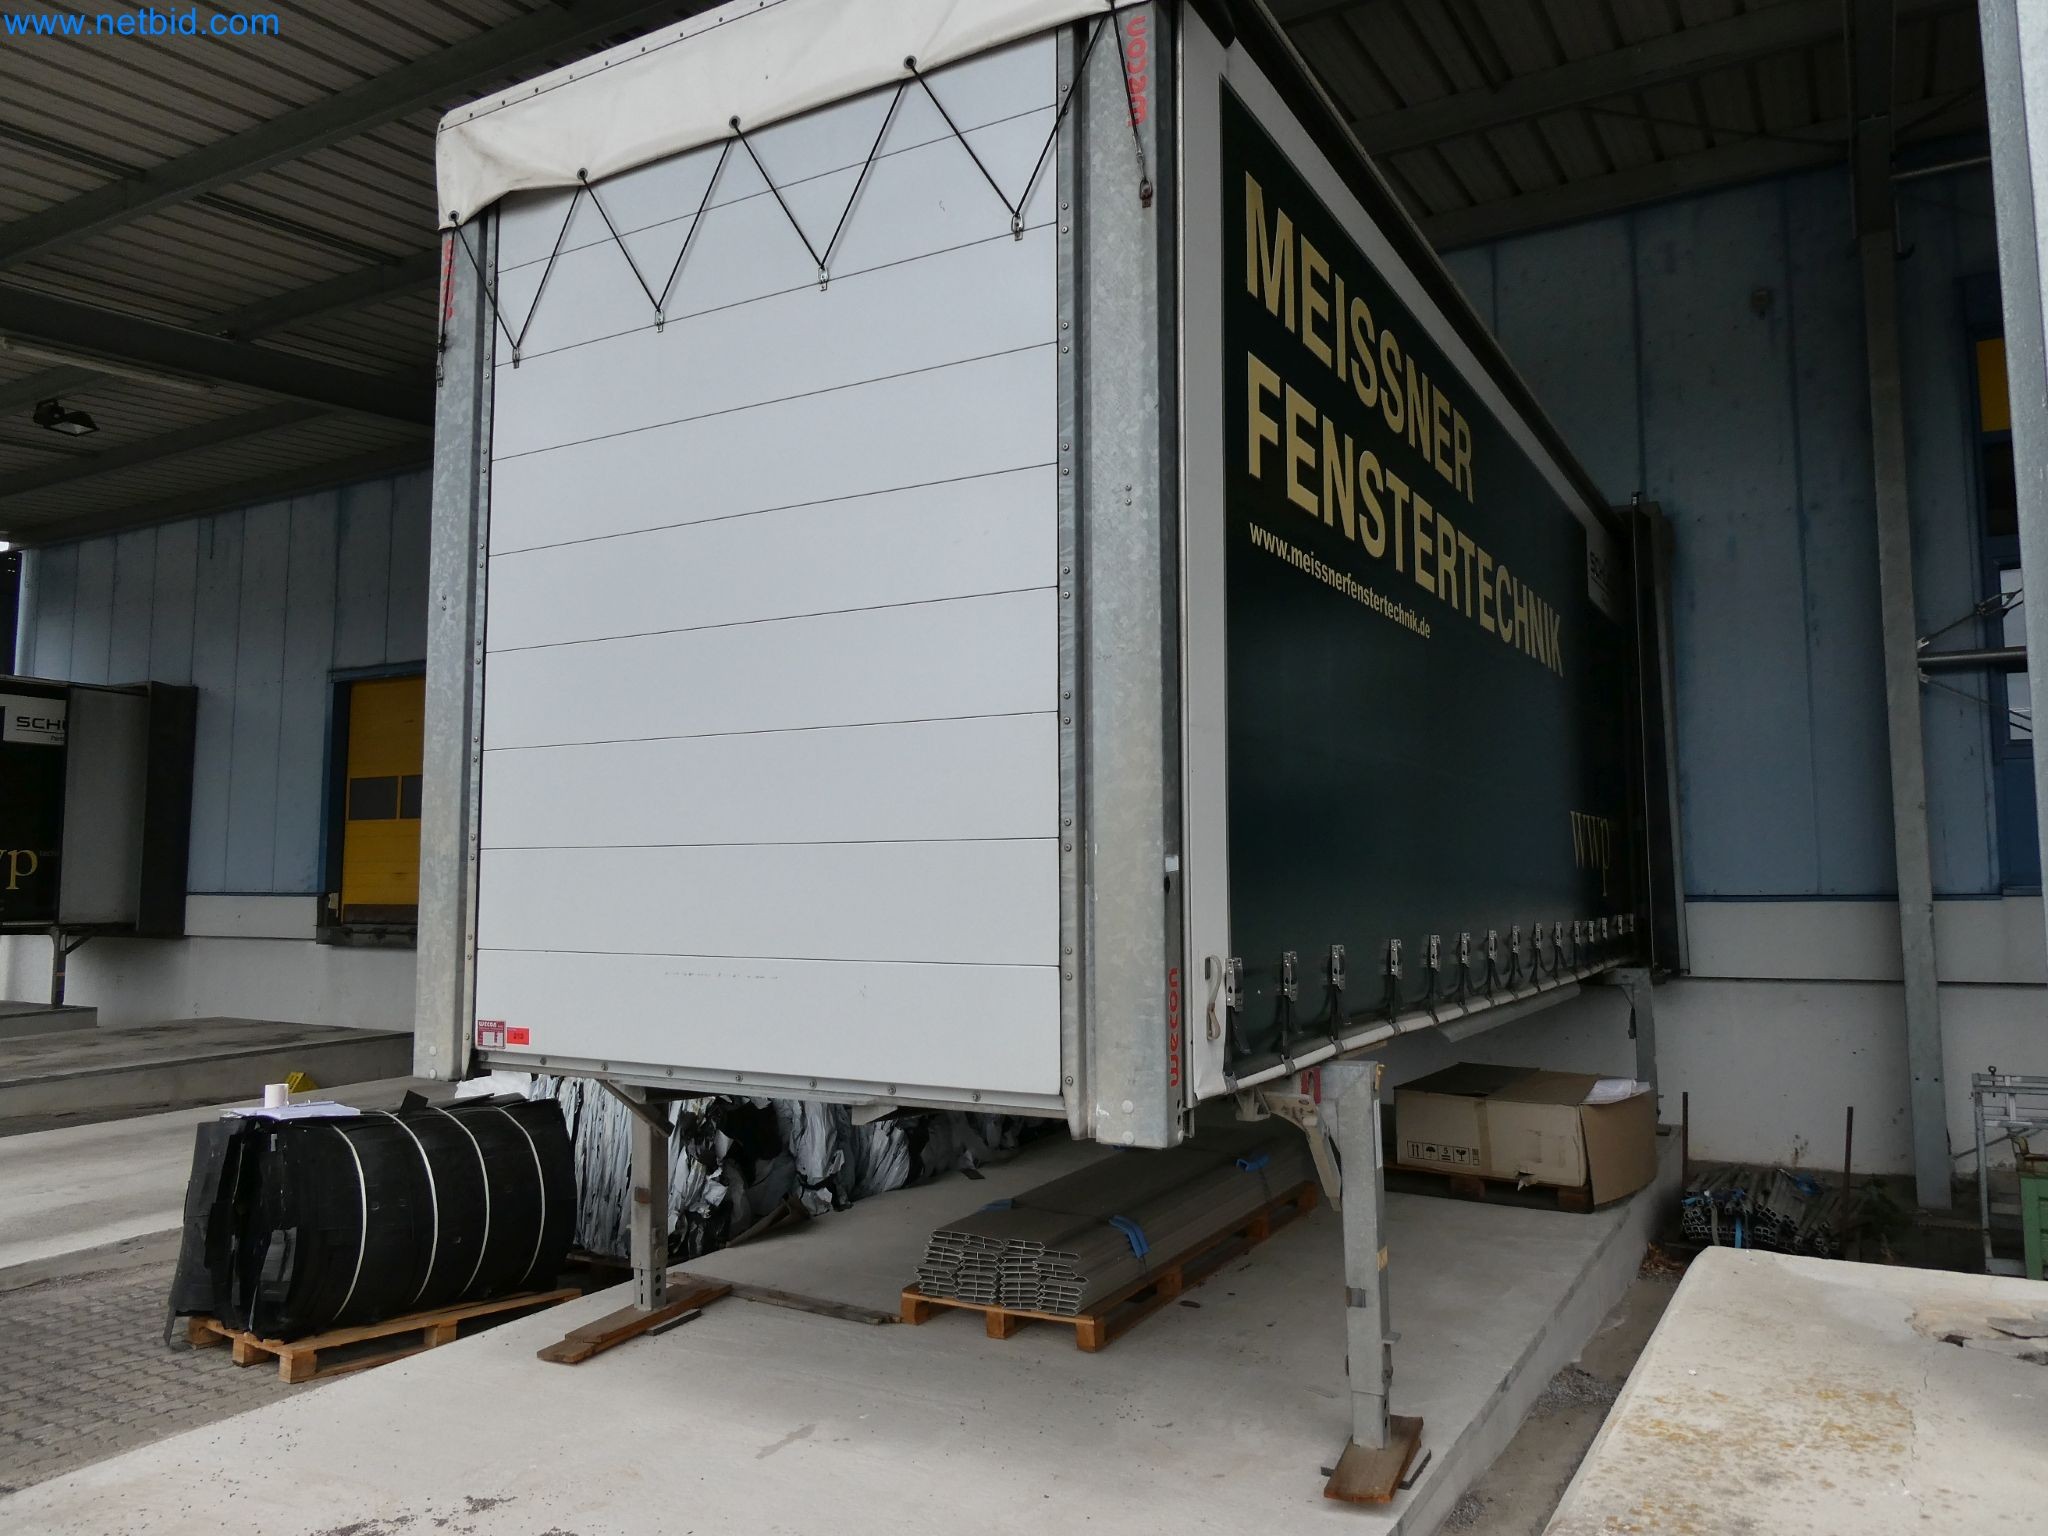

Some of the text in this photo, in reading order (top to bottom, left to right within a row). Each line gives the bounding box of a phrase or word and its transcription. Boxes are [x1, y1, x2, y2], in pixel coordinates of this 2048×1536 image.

[1245, 171, 1475, 503] MEISSNER
[1247, 351, 1564, 677] FENSTERTECHNIK
[1249, 521, 1431, 639] www.meissnerfenstertechnik.de
[1167, 967, 1178, 1087] wecon
